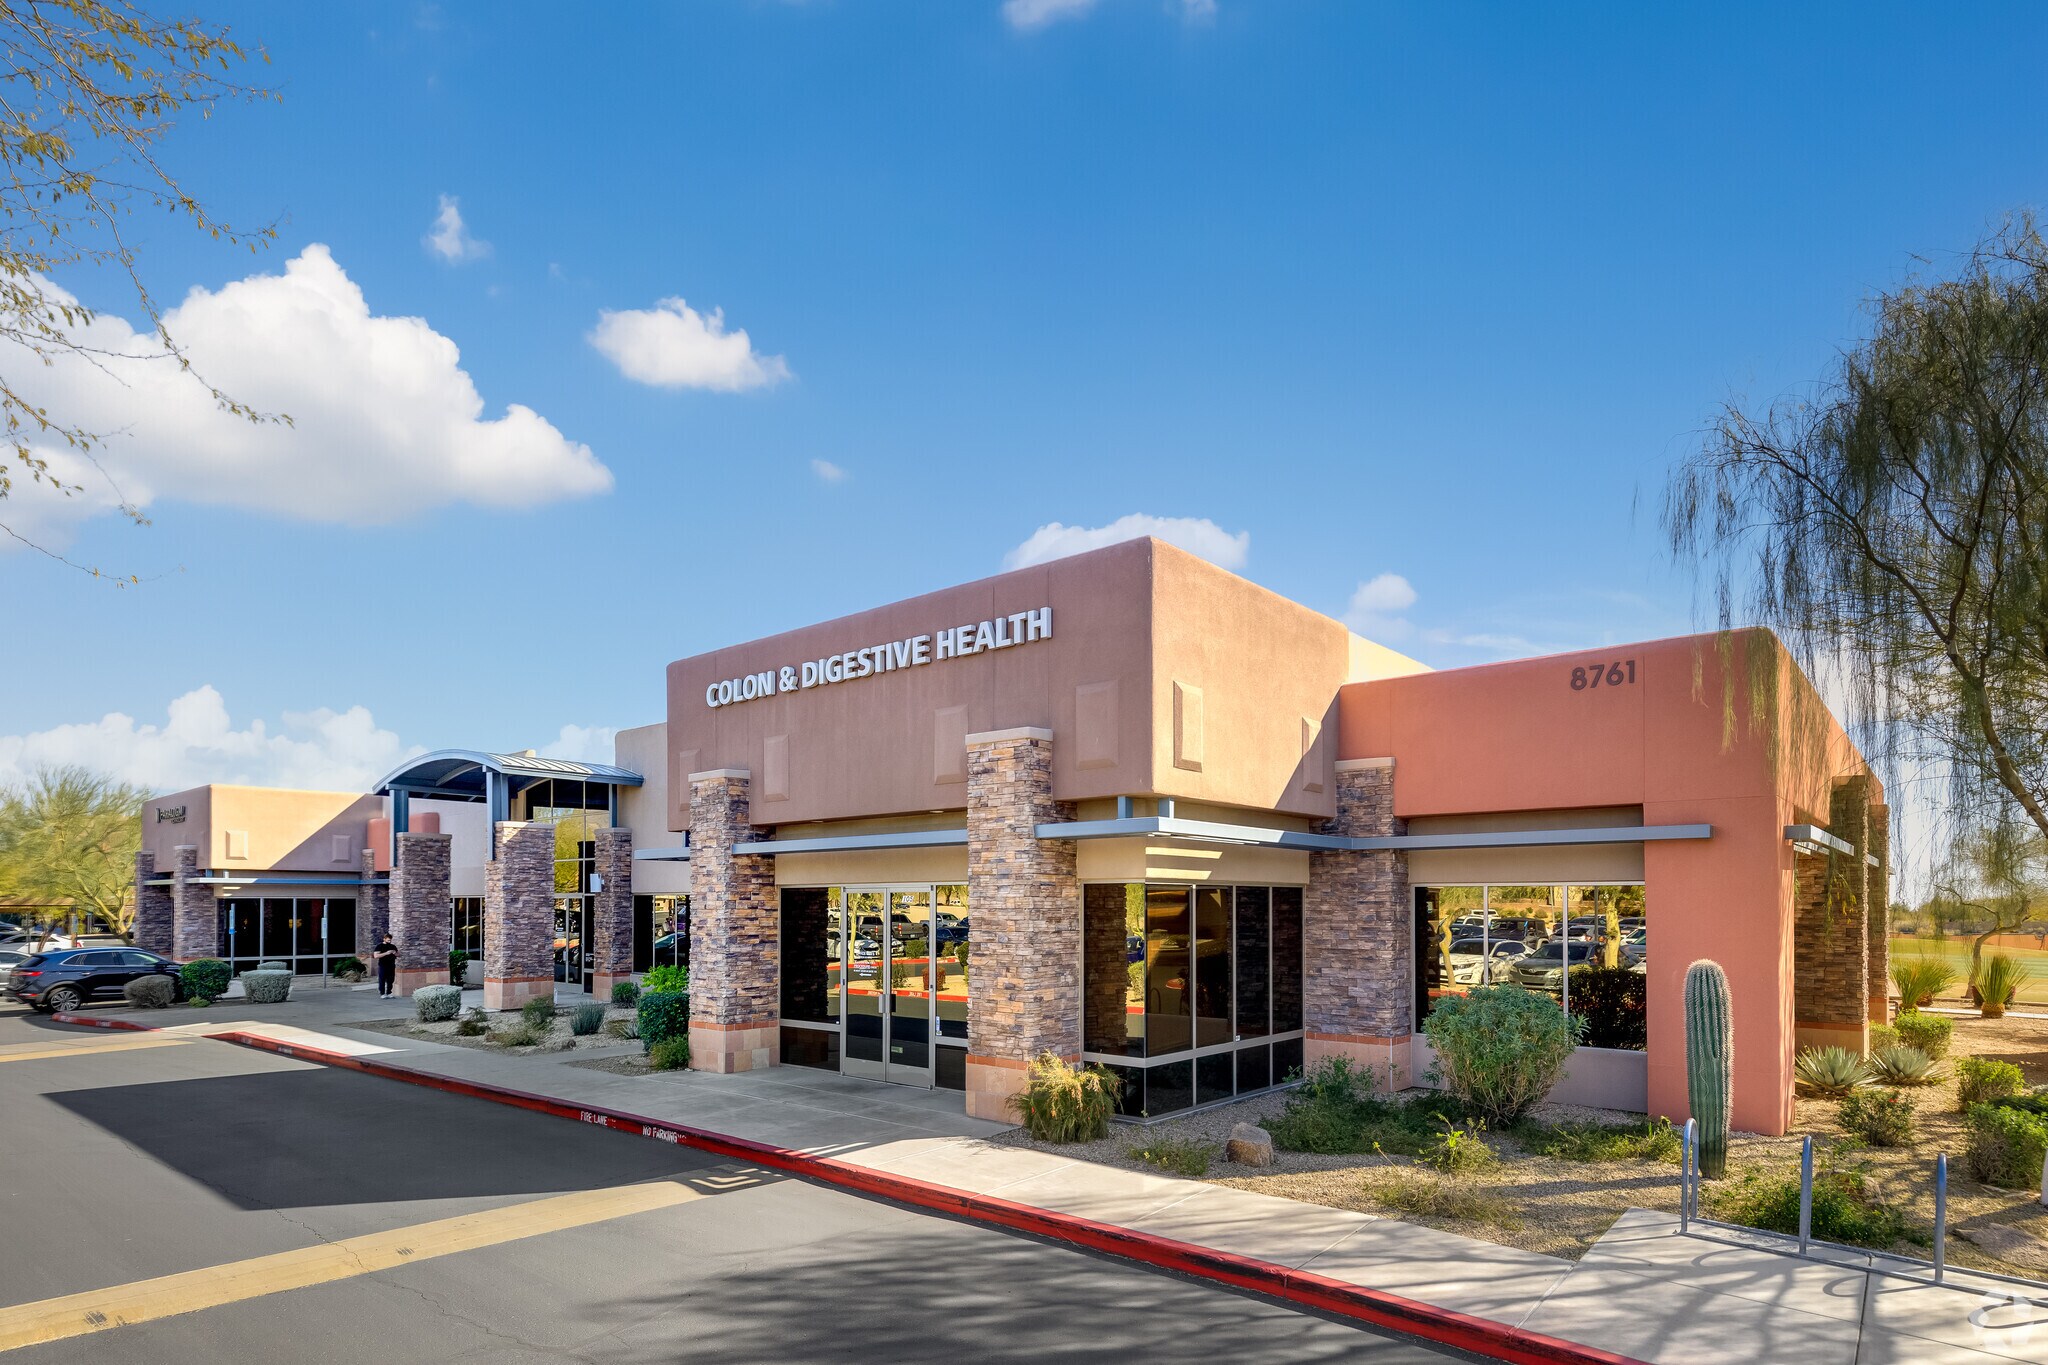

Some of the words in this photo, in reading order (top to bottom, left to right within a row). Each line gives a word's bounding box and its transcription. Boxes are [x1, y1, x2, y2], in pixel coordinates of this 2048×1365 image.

[705, 670, 776, 708] COLON
[779, 665, 799, 693] &
[801, 634, 931, 689] DIGESTIVE
[936, 606, 1053, 660] HEALTH
[1570, 660, 1635, 691] 8761
[580, 1110, 593, 1123] FIRE
[593, 1114, 608, 1126] LANE
[642, 1125, 652, 1137] NO
[652, 1126, 678, 1143] PARKING
